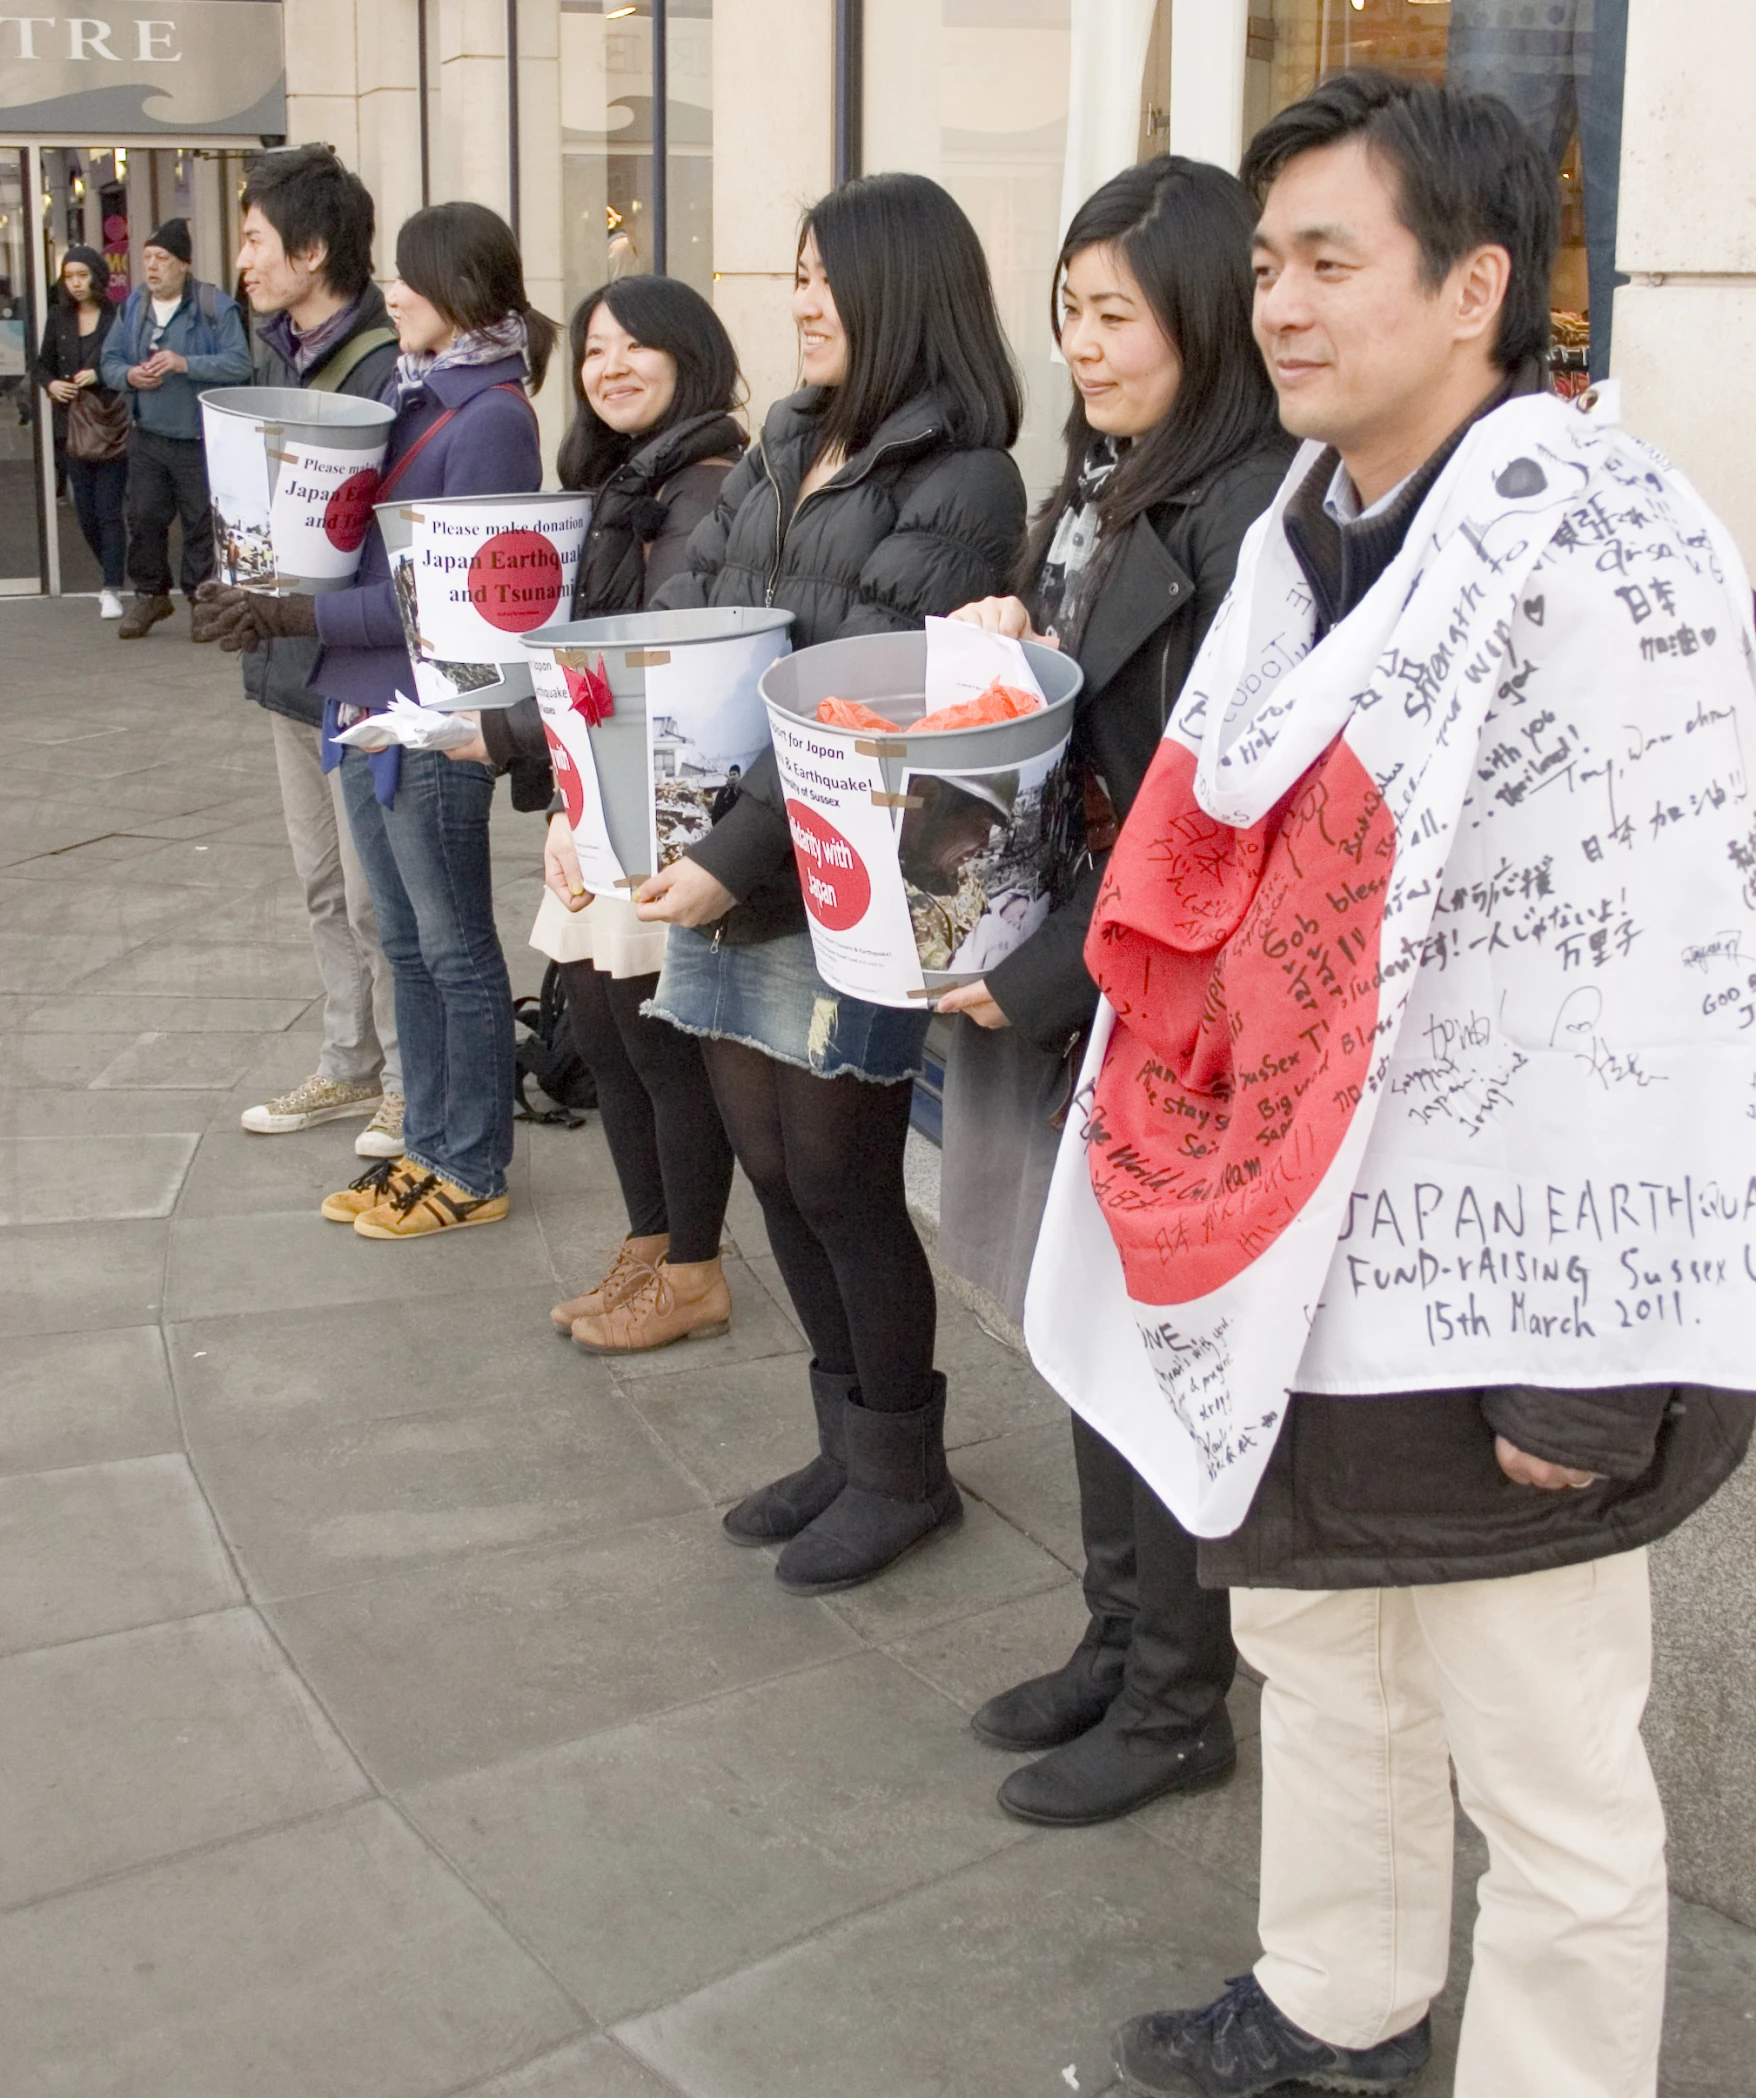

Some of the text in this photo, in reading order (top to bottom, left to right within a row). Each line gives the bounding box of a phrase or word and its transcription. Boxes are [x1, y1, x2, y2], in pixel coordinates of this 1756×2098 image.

[0, 17, 182, 62] TRE
[304, 457, 346, 475] Please
[285, 480, 341, 503] Japan
[305, 514, 337, 530] and
[432, 516, 584, 536] Please make donation
[422, 549, 482, 573] Japan
[449, 578, 575, 604] and Tsunami
[1613, 576, 1676, 625] 日本
[789, 732, 803, 748] for
[806, 740, 844, 760] Japan
[793, 763, 872, 792] Earthquake!
[810, 789, 841, 808] Sussex
[821, 838, 854, 869] with
[807, 867, 838, 915] Japan
[1702, 986, 1741, 1016] GOD
[1337, 1183, 1525, 1246] JAPAN
[1620, 1247, 1727, 1290] Sussex
[1425, 1292, 1491, 1347] 15th
[1510, 1291, 1597, 1338] March
